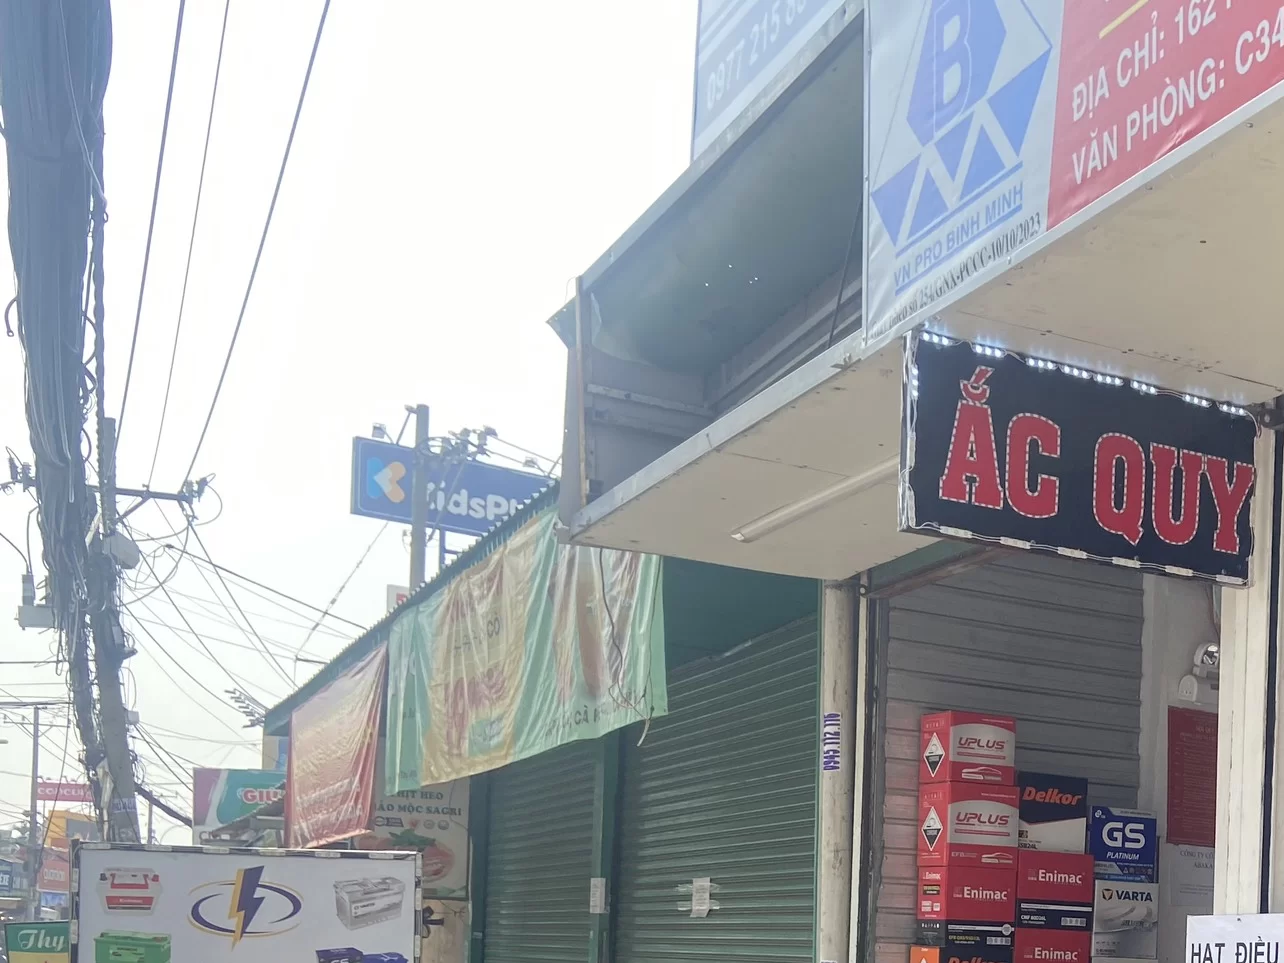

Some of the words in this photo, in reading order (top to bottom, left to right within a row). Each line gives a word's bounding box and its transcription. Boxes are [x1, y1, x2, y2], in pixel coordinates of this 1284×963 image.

[1072, 67, 1110, 121] ĐỊA
[1117, 10, 1165, 88] CHỈ:
[1175, 0, 1217, 44] 162
[707, 38, 745, 111] 0977
[1072, 127, 1118, 185] VĂN
[1126, 57, 1224, 151] PHÒNG:
[893, 262, 911, 288] VN
[915, 240, 942, 273] PRO
[985, 180, 1023, 227] MINH
[939, 367, 1061, 518] ẮC
[1092, 432, 1255, 554] QUY
[958, 737, 1005, 750] UPLUS
[1023, 787, 1082, 806] Delkor
[956, 812, 1010, 825] UPLUS
[1102, 822, 1146, 849] GS
[1106, 852, 1140, 860] PLATINUM
[1038, 869, 1083, 884] Enimac
[963, 886, 1008, 900] Enimac
[1116, 889, 1153, 902] VARTA
[1034, 947, 1079, 960] Enimac
